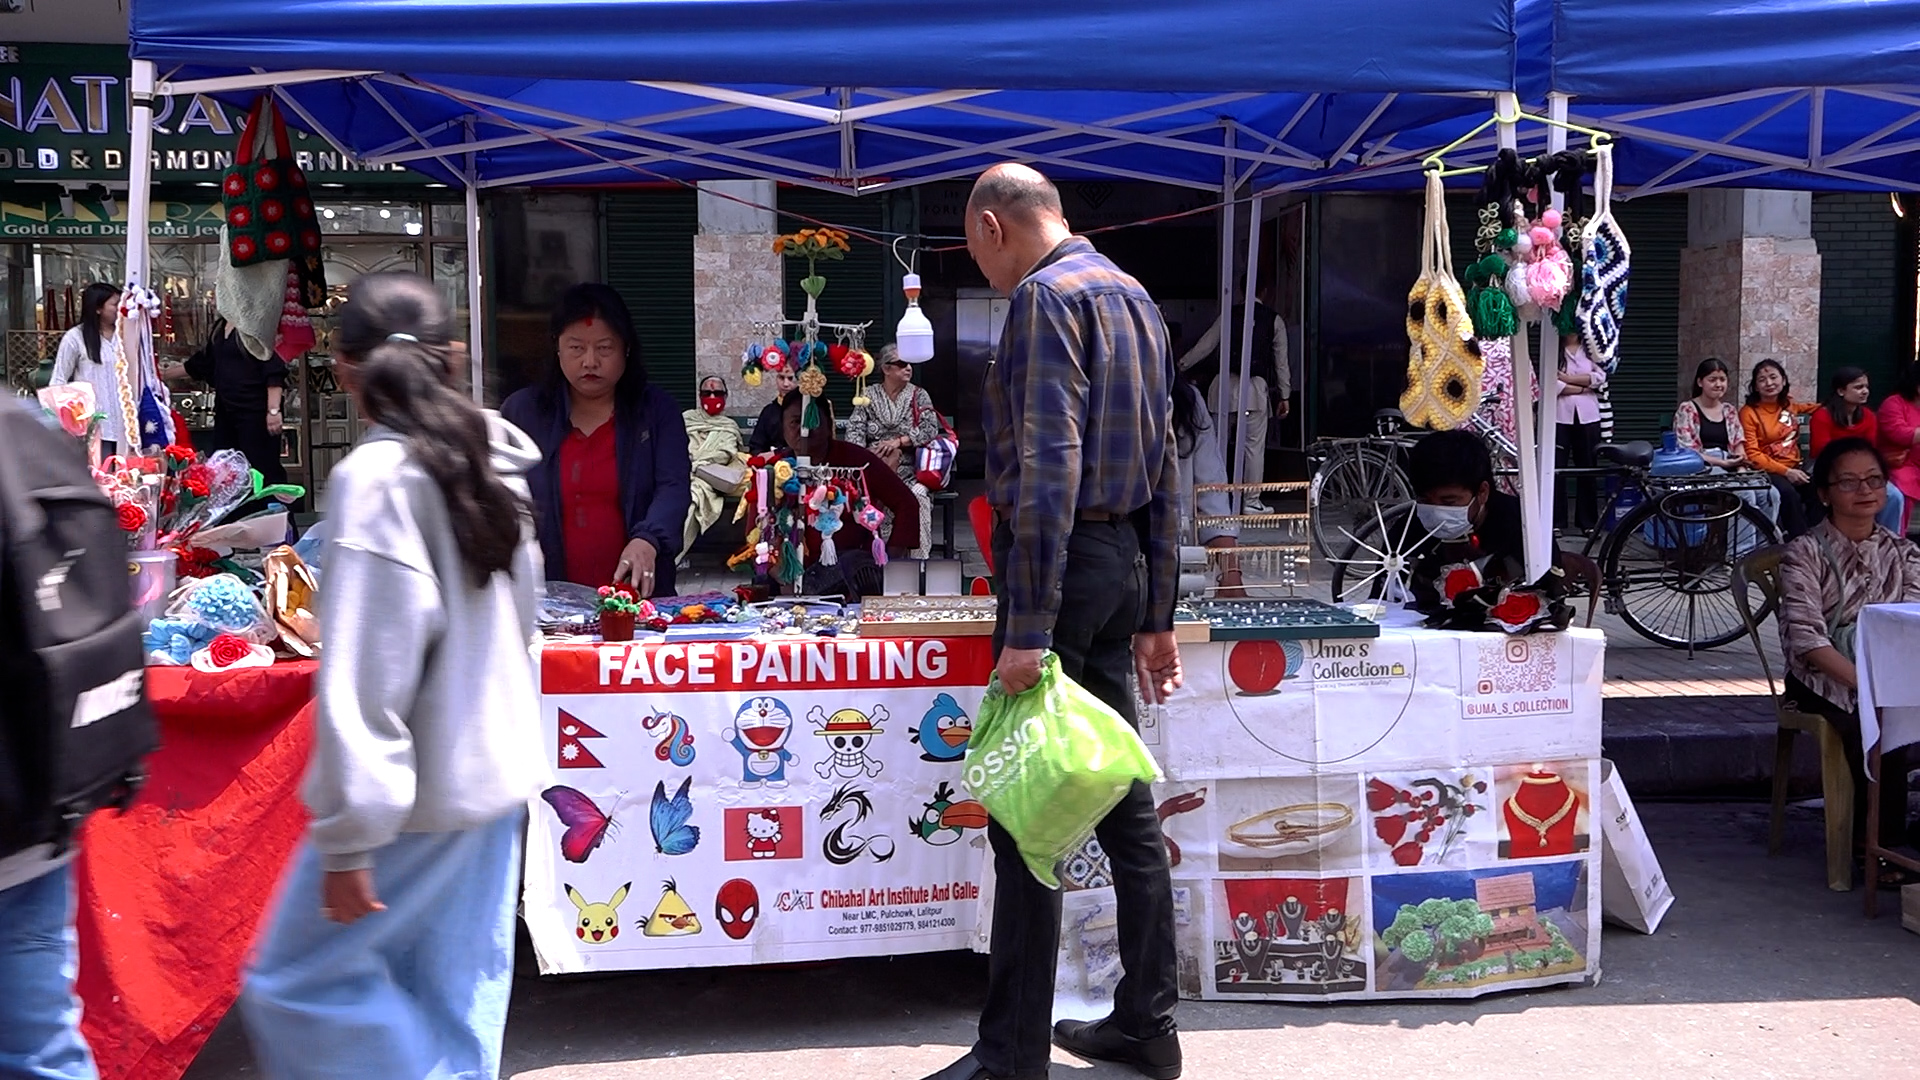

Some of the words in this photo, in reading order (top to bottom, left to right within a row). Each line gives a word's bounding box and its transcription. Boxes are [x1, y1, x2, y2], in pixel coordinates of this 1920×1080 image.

[70, 149, 91, 169] &
[3, 223, 49, 235] Gold
[56, 223, 92, 235] and
[101, 223, 188, 235] Diaond
[599, 642, 716, 686] FACE
[731, 640, 948, 684] PAINTING
[1312, 661, 1389, 679] Collection
[1467, 699, 1569, 715] @UMA_S_COLLECTION
[820, 887, 865, 909] Chibahal
[868, 888, 884, 907] Art
[887, 886, 928, 906] Institute
[932, 883, 950, 902] And
[842, 912, 859, 921] Near
[881, 908, 915, 919] Pulchowk,
[917, 906, 942, 918] Lalitpur
